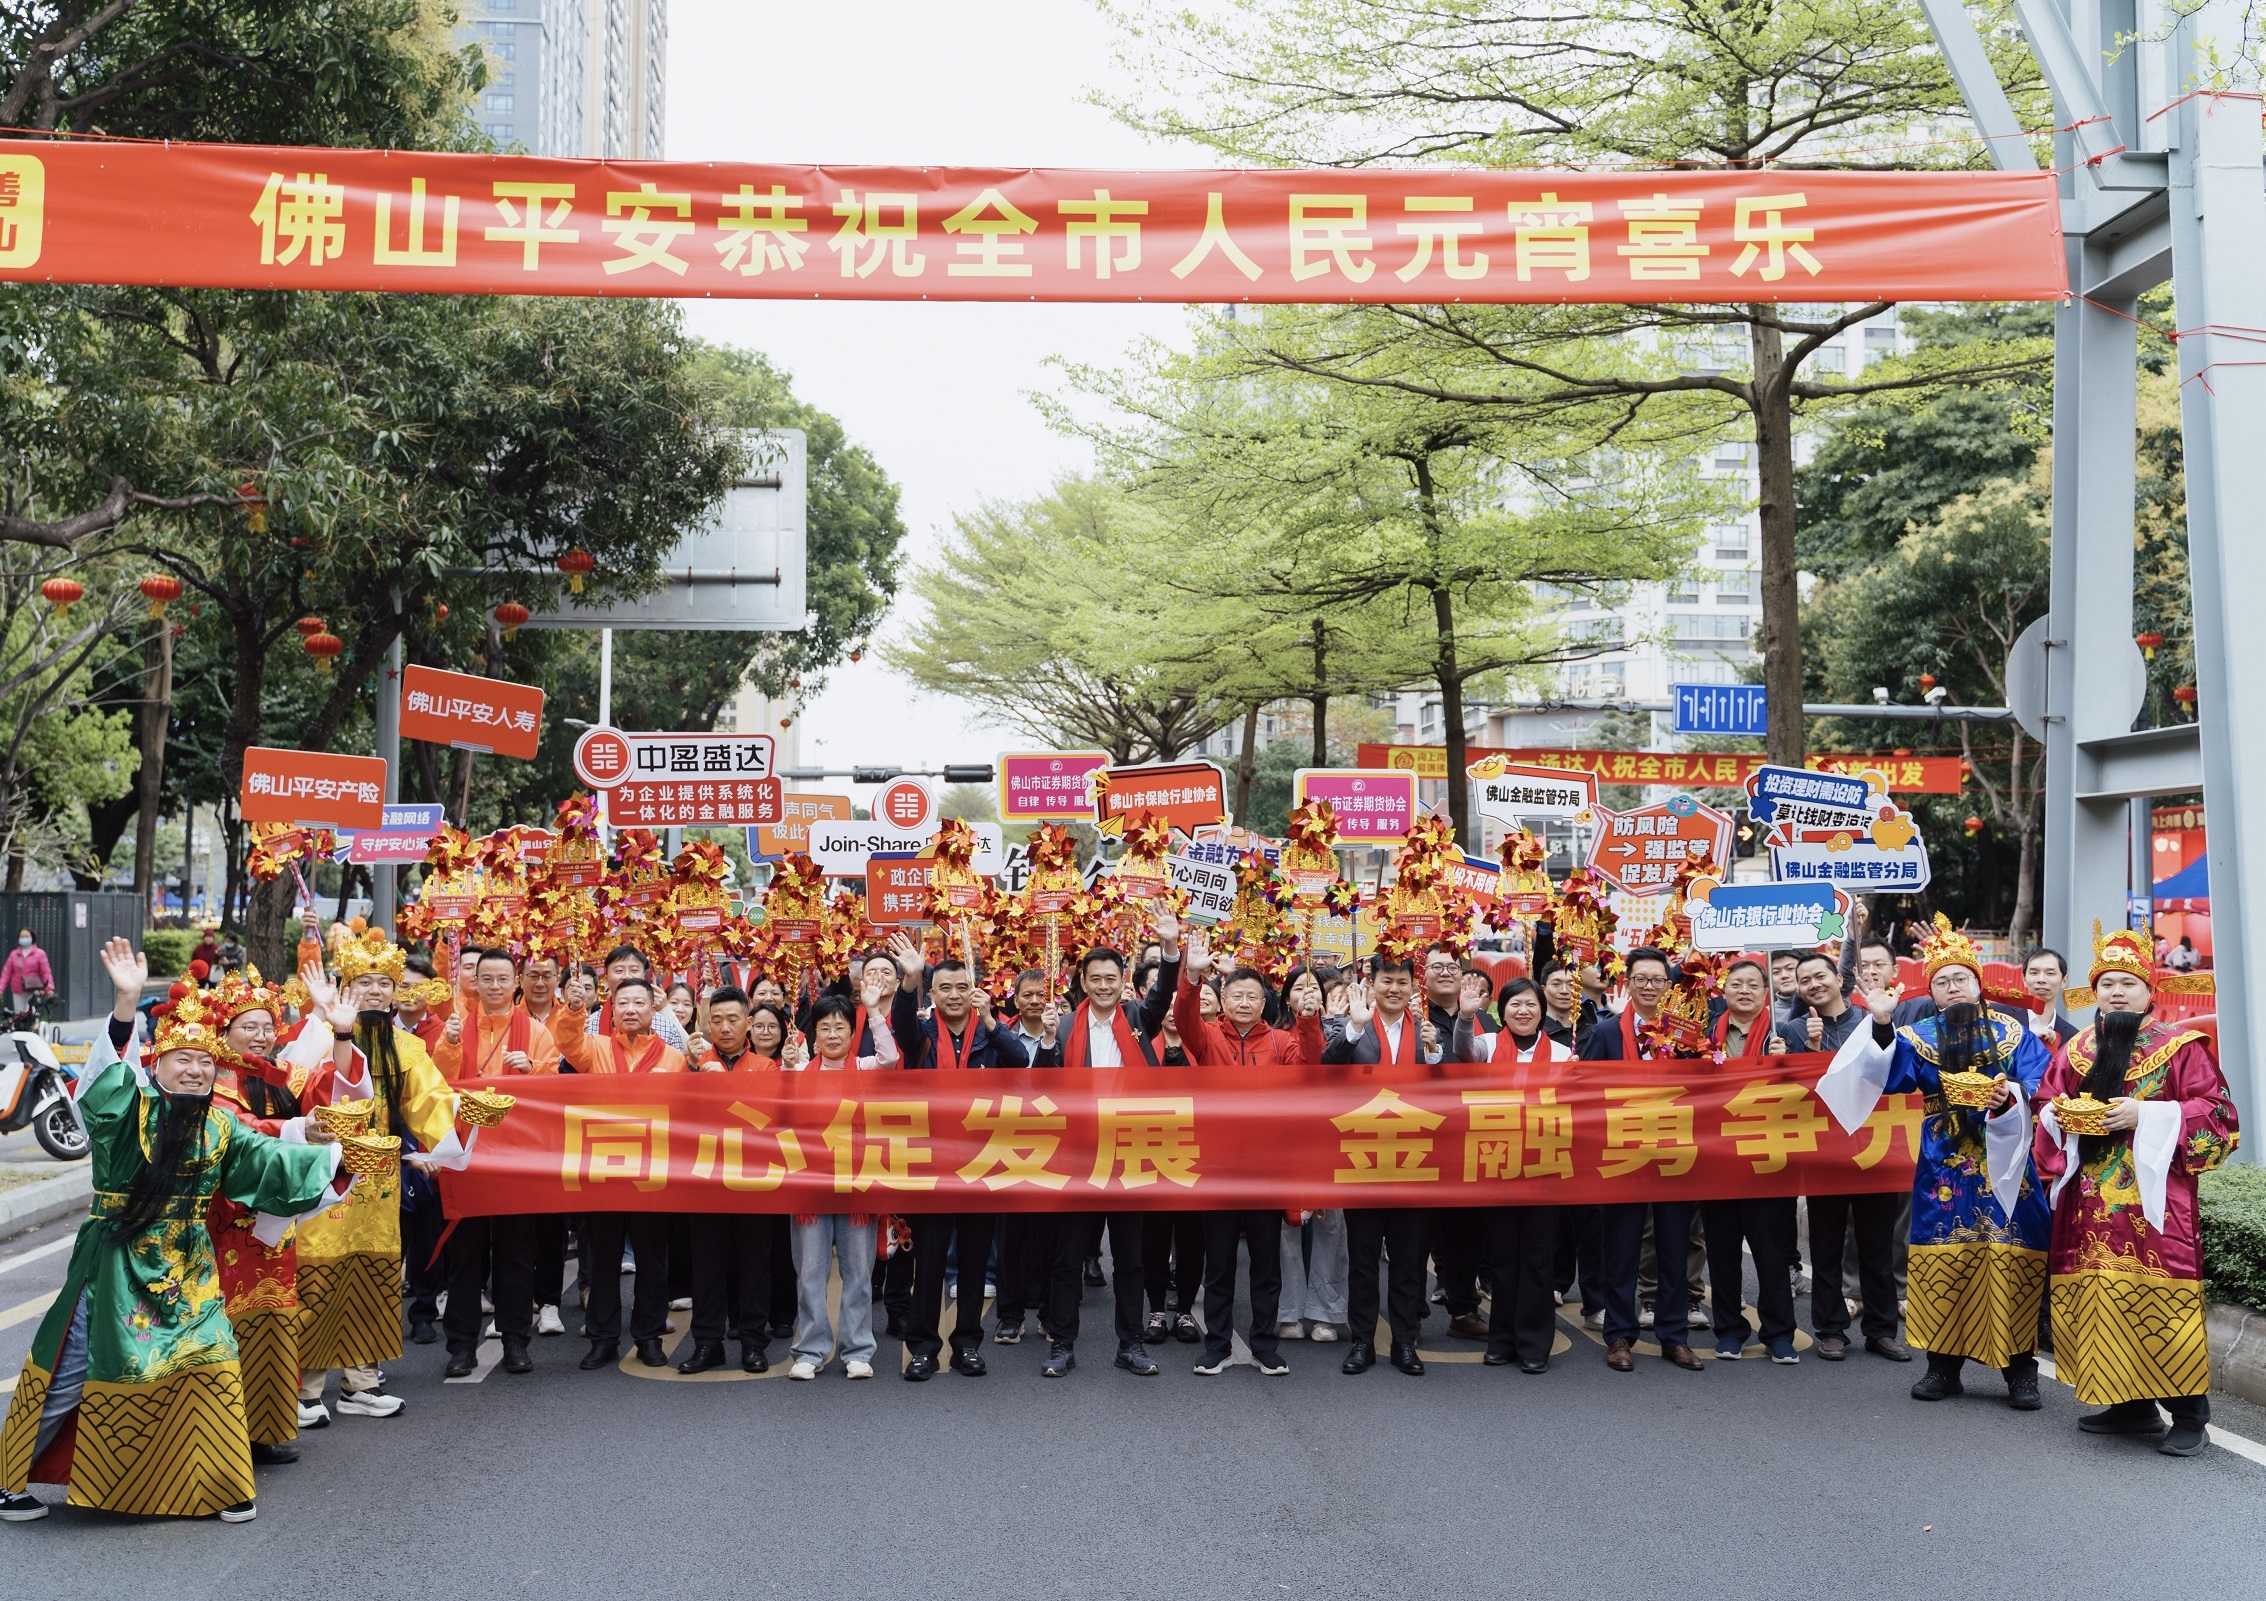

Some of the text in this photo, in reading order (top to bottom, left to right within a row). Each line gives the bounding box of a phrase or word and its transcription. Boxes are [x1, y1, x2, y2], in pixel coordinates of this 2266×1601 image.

[250, 172, 1822, 284] 佛山平安恭祝全市人民元宵喜乐
[406, 690, 537, 733] 佛山平安人寿
[636, 743, 766, 772] 中盈盛达
[1489, 752, 1738, 783] 一汤达人祝全市人民
[247, 772, 381, 804] 佛山平安产险
[619, 784, 774, 803] 为企业提供系统化
[1109, 786, 1217, 810] 佛山市保险行业协会
[1486, 785, 1580, 807] 佛山金融监管分局
[1764, 773, 1864, 806] 投资理财需设防
[619, 802, 774, 821] 一体化的金融服务
[1018, 796, 1040, 807] 自律
[1046, 796, 1068, 807] 传导
[772, 823, 812, 841] 彼此
[1347, 817, 1400, 830] 传导 服务
[1612, 815, 1679, 837] 防风险
[819, 835, 922, 853] Join-Share
[1187, 842, 1280, 869] 金融为民
[1644, 839, 1711, 861] 强监管
[1785, 861, 1918, 880] 佛山金融监管分局
[1174, 884, 1234, 913] 下同欲
[1700, 903, 1825, 930] 佛山市银行业协会
[561, 1094, 1203, 1193] 同心促发展
